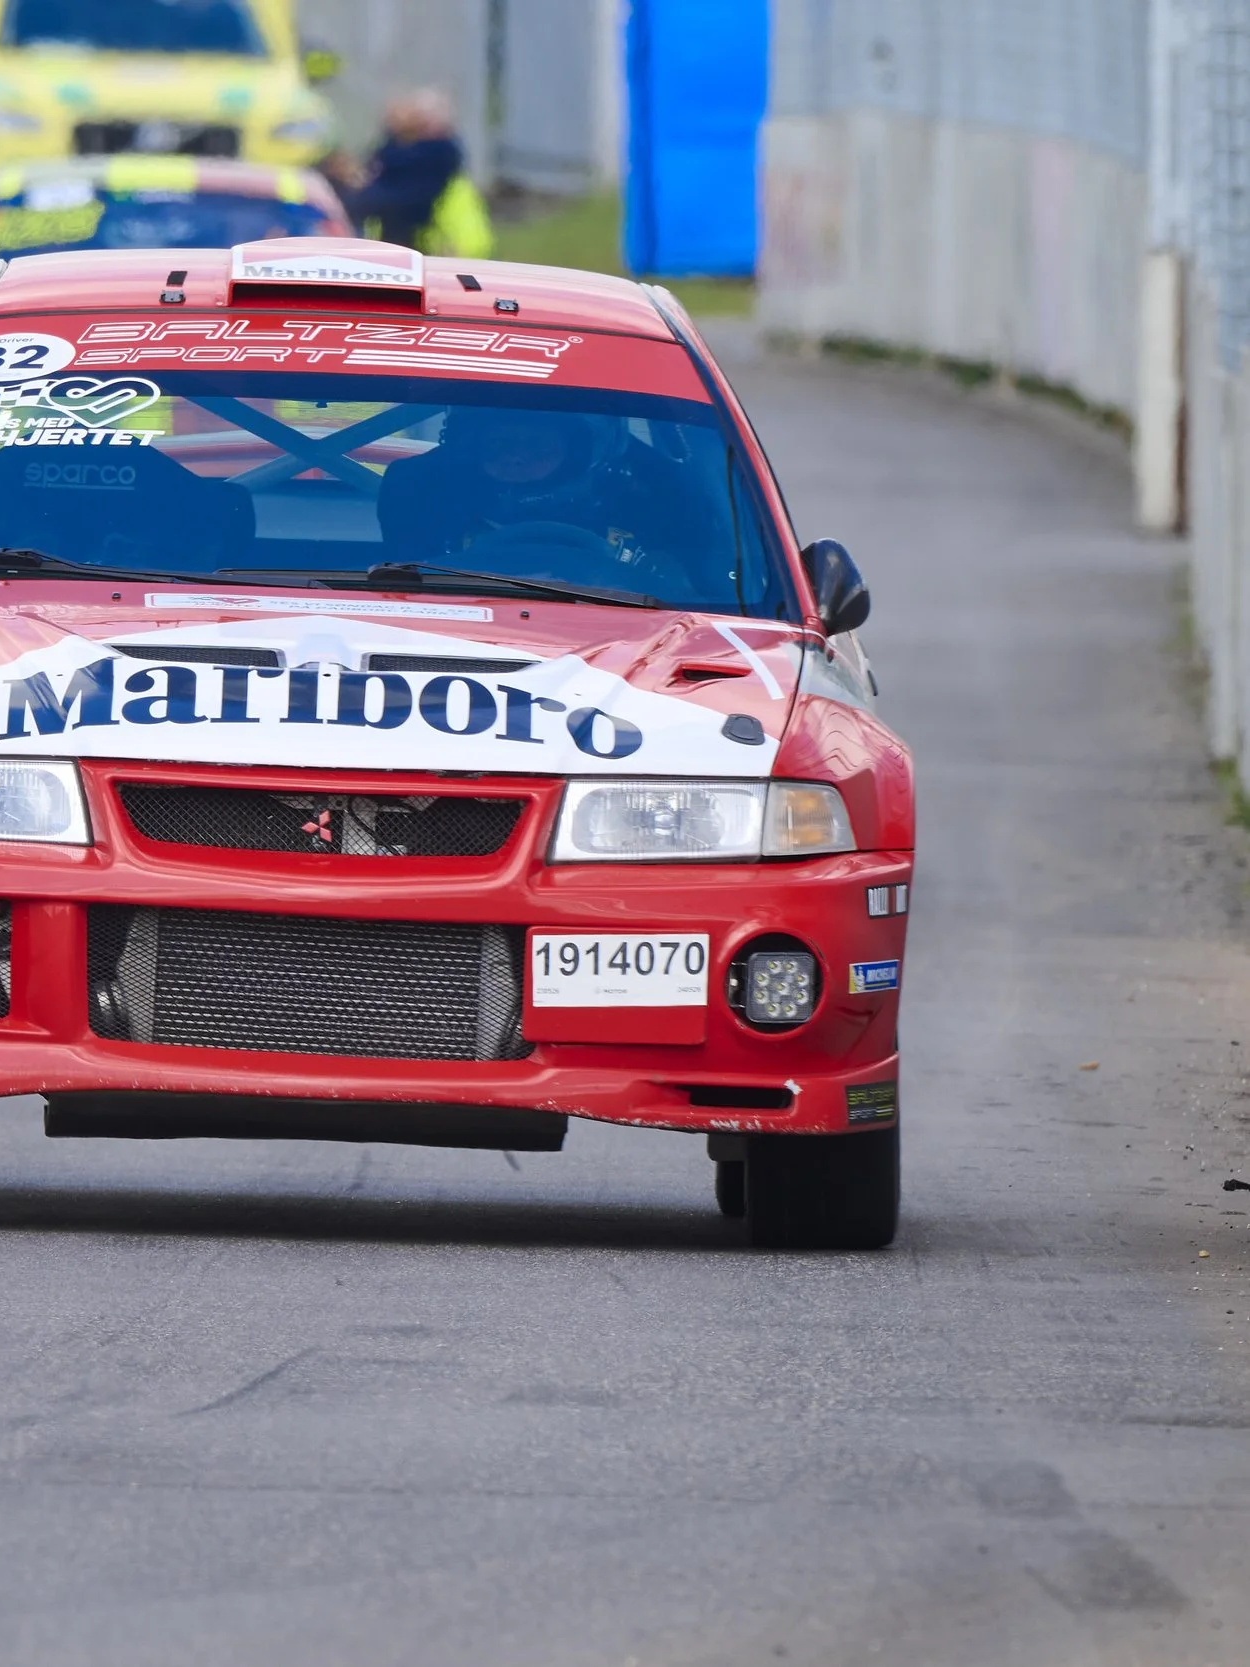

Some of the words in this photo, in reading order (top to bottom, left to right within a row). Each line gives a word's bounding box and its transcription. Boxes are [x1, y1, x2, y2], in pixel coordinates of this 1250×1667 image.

[243, 264, 413, 283] Marlboro
[0, 336, 34, 344] Driver
[77, 319, 571, 358] BALTZER
[74, 345, 347, 366] SPORT
[24, 417, 75, 429] MED
[25, 462, 136, 488] sparco
[536, 941, 705, 976] 1914070
